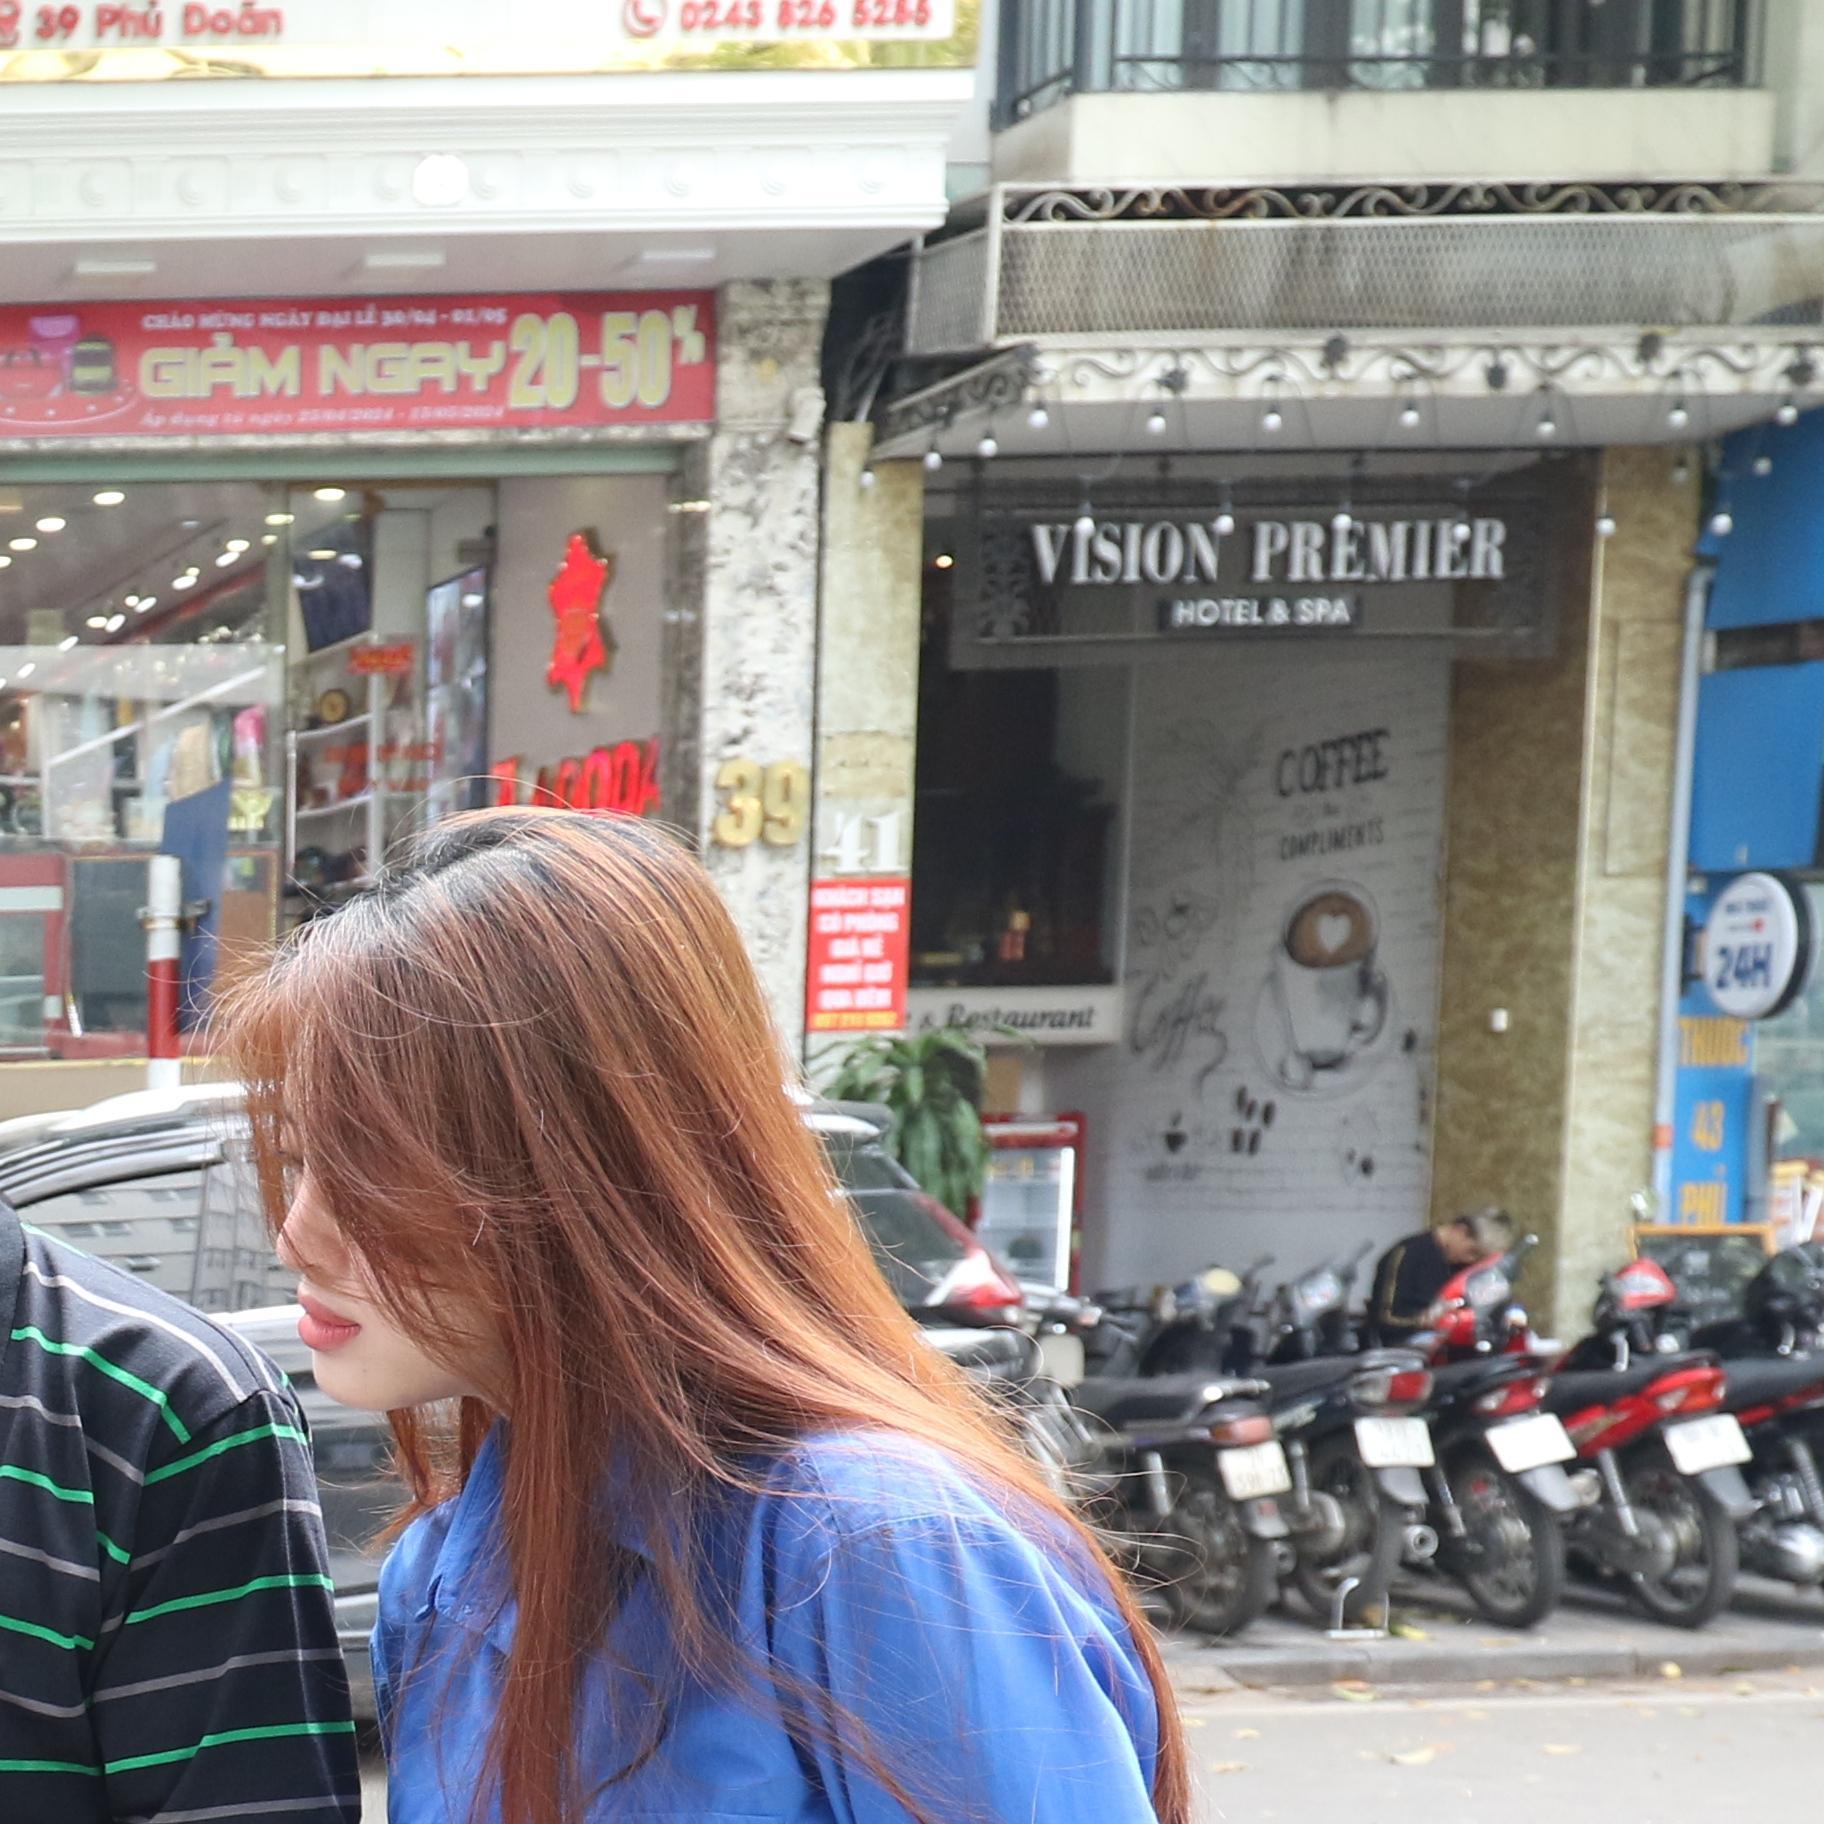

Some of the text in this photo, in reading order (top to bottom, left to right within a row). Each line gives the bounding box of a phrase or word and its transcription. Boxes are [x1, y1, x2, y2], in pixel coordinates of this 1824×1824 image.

[35, 4, 81, 41] 39
[139, 304, 706, 410] GIẢM NGAY 20-50%
[1031, 516, 1508, 586] VISION PREMIER
[1173, 596, 1351, 628] HOTEL & SPA
[1276, 728, 1392, 798] COFFEE
[712, 758, 812, 848] 39
[818, 809, 907, 873] 41
[1716, 941, 1775, 990] 24H
[946, 1002, 1095, 1030] Restaurant
